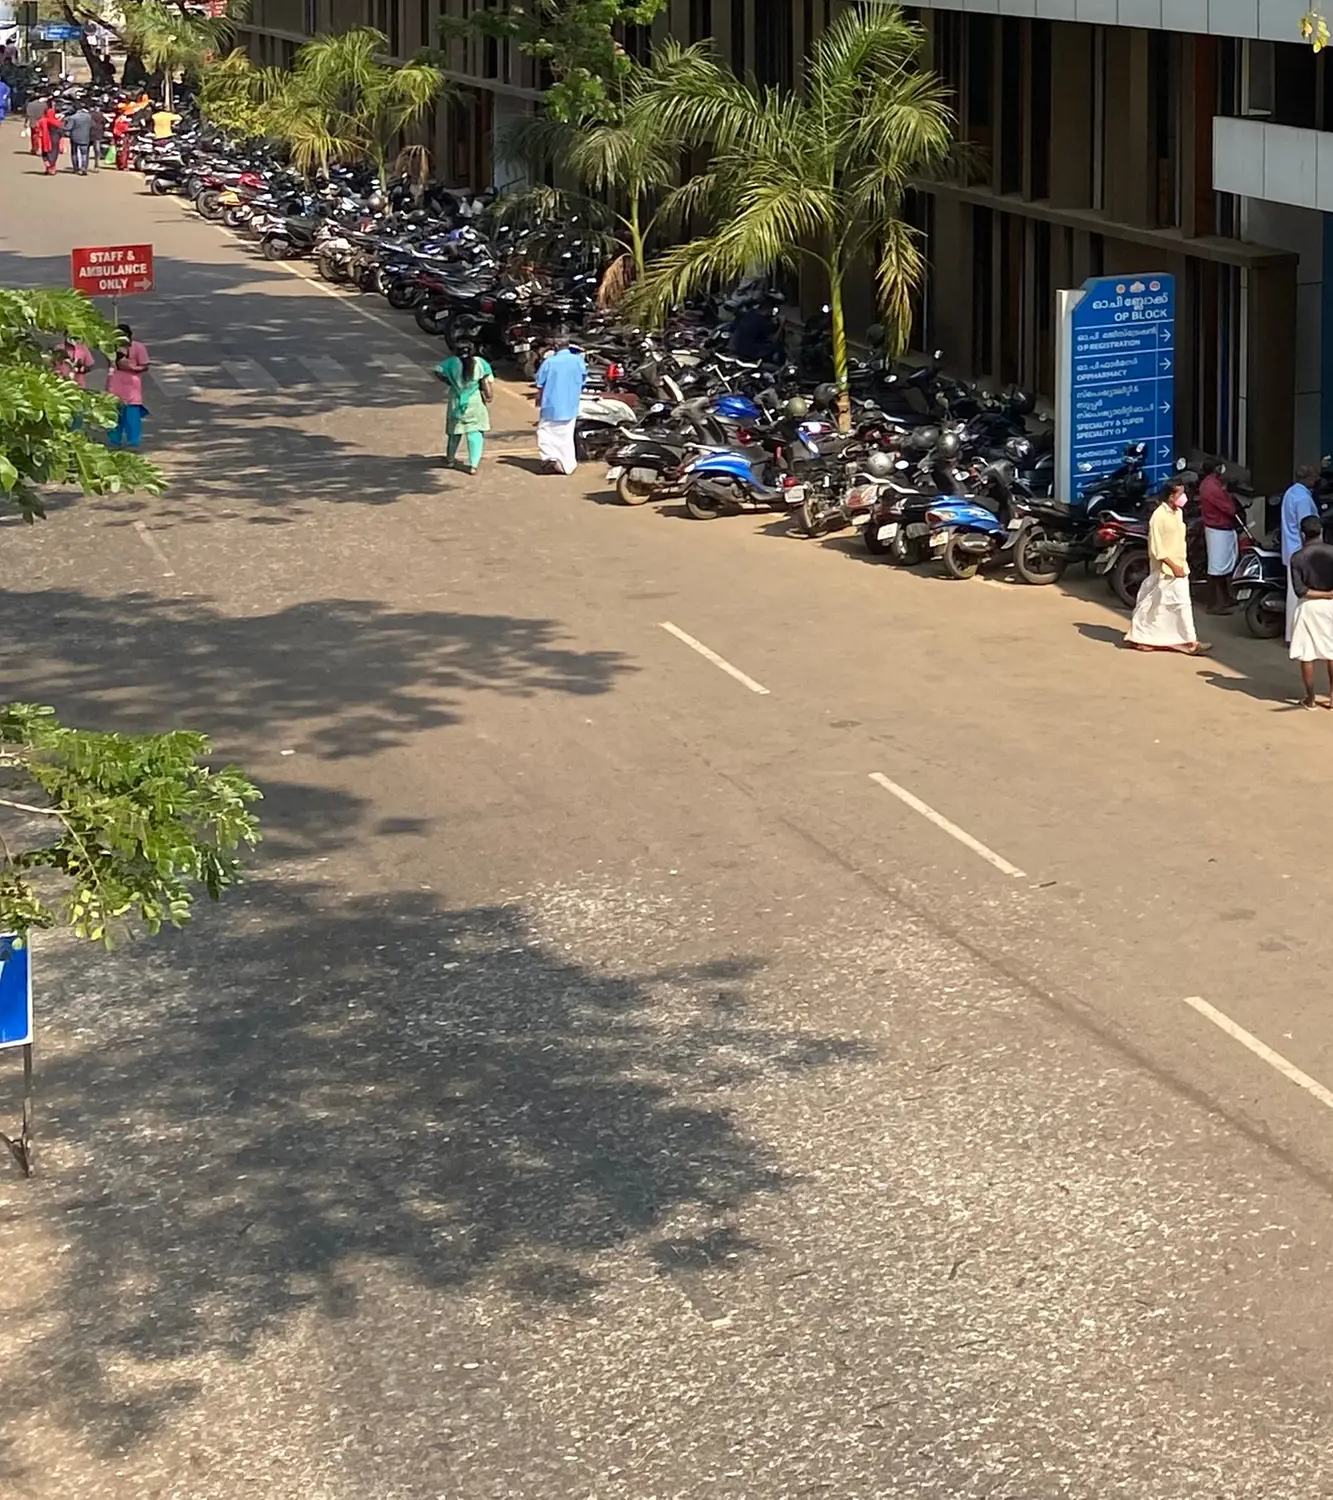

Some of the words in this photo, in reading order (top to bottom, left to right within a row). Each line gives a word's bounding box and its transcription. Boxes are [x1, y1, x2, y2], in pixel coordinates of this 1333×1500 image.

[90, 251, 123, 263] STAFF
[127, 250, 135, 261] &
[79, 263, 147, 278] AMBULANCE
[99, 278, 129, 290] ONLY
[1114, 312, 1129, 322] OP
[1131, 309, 1168, 321] BLOCK
